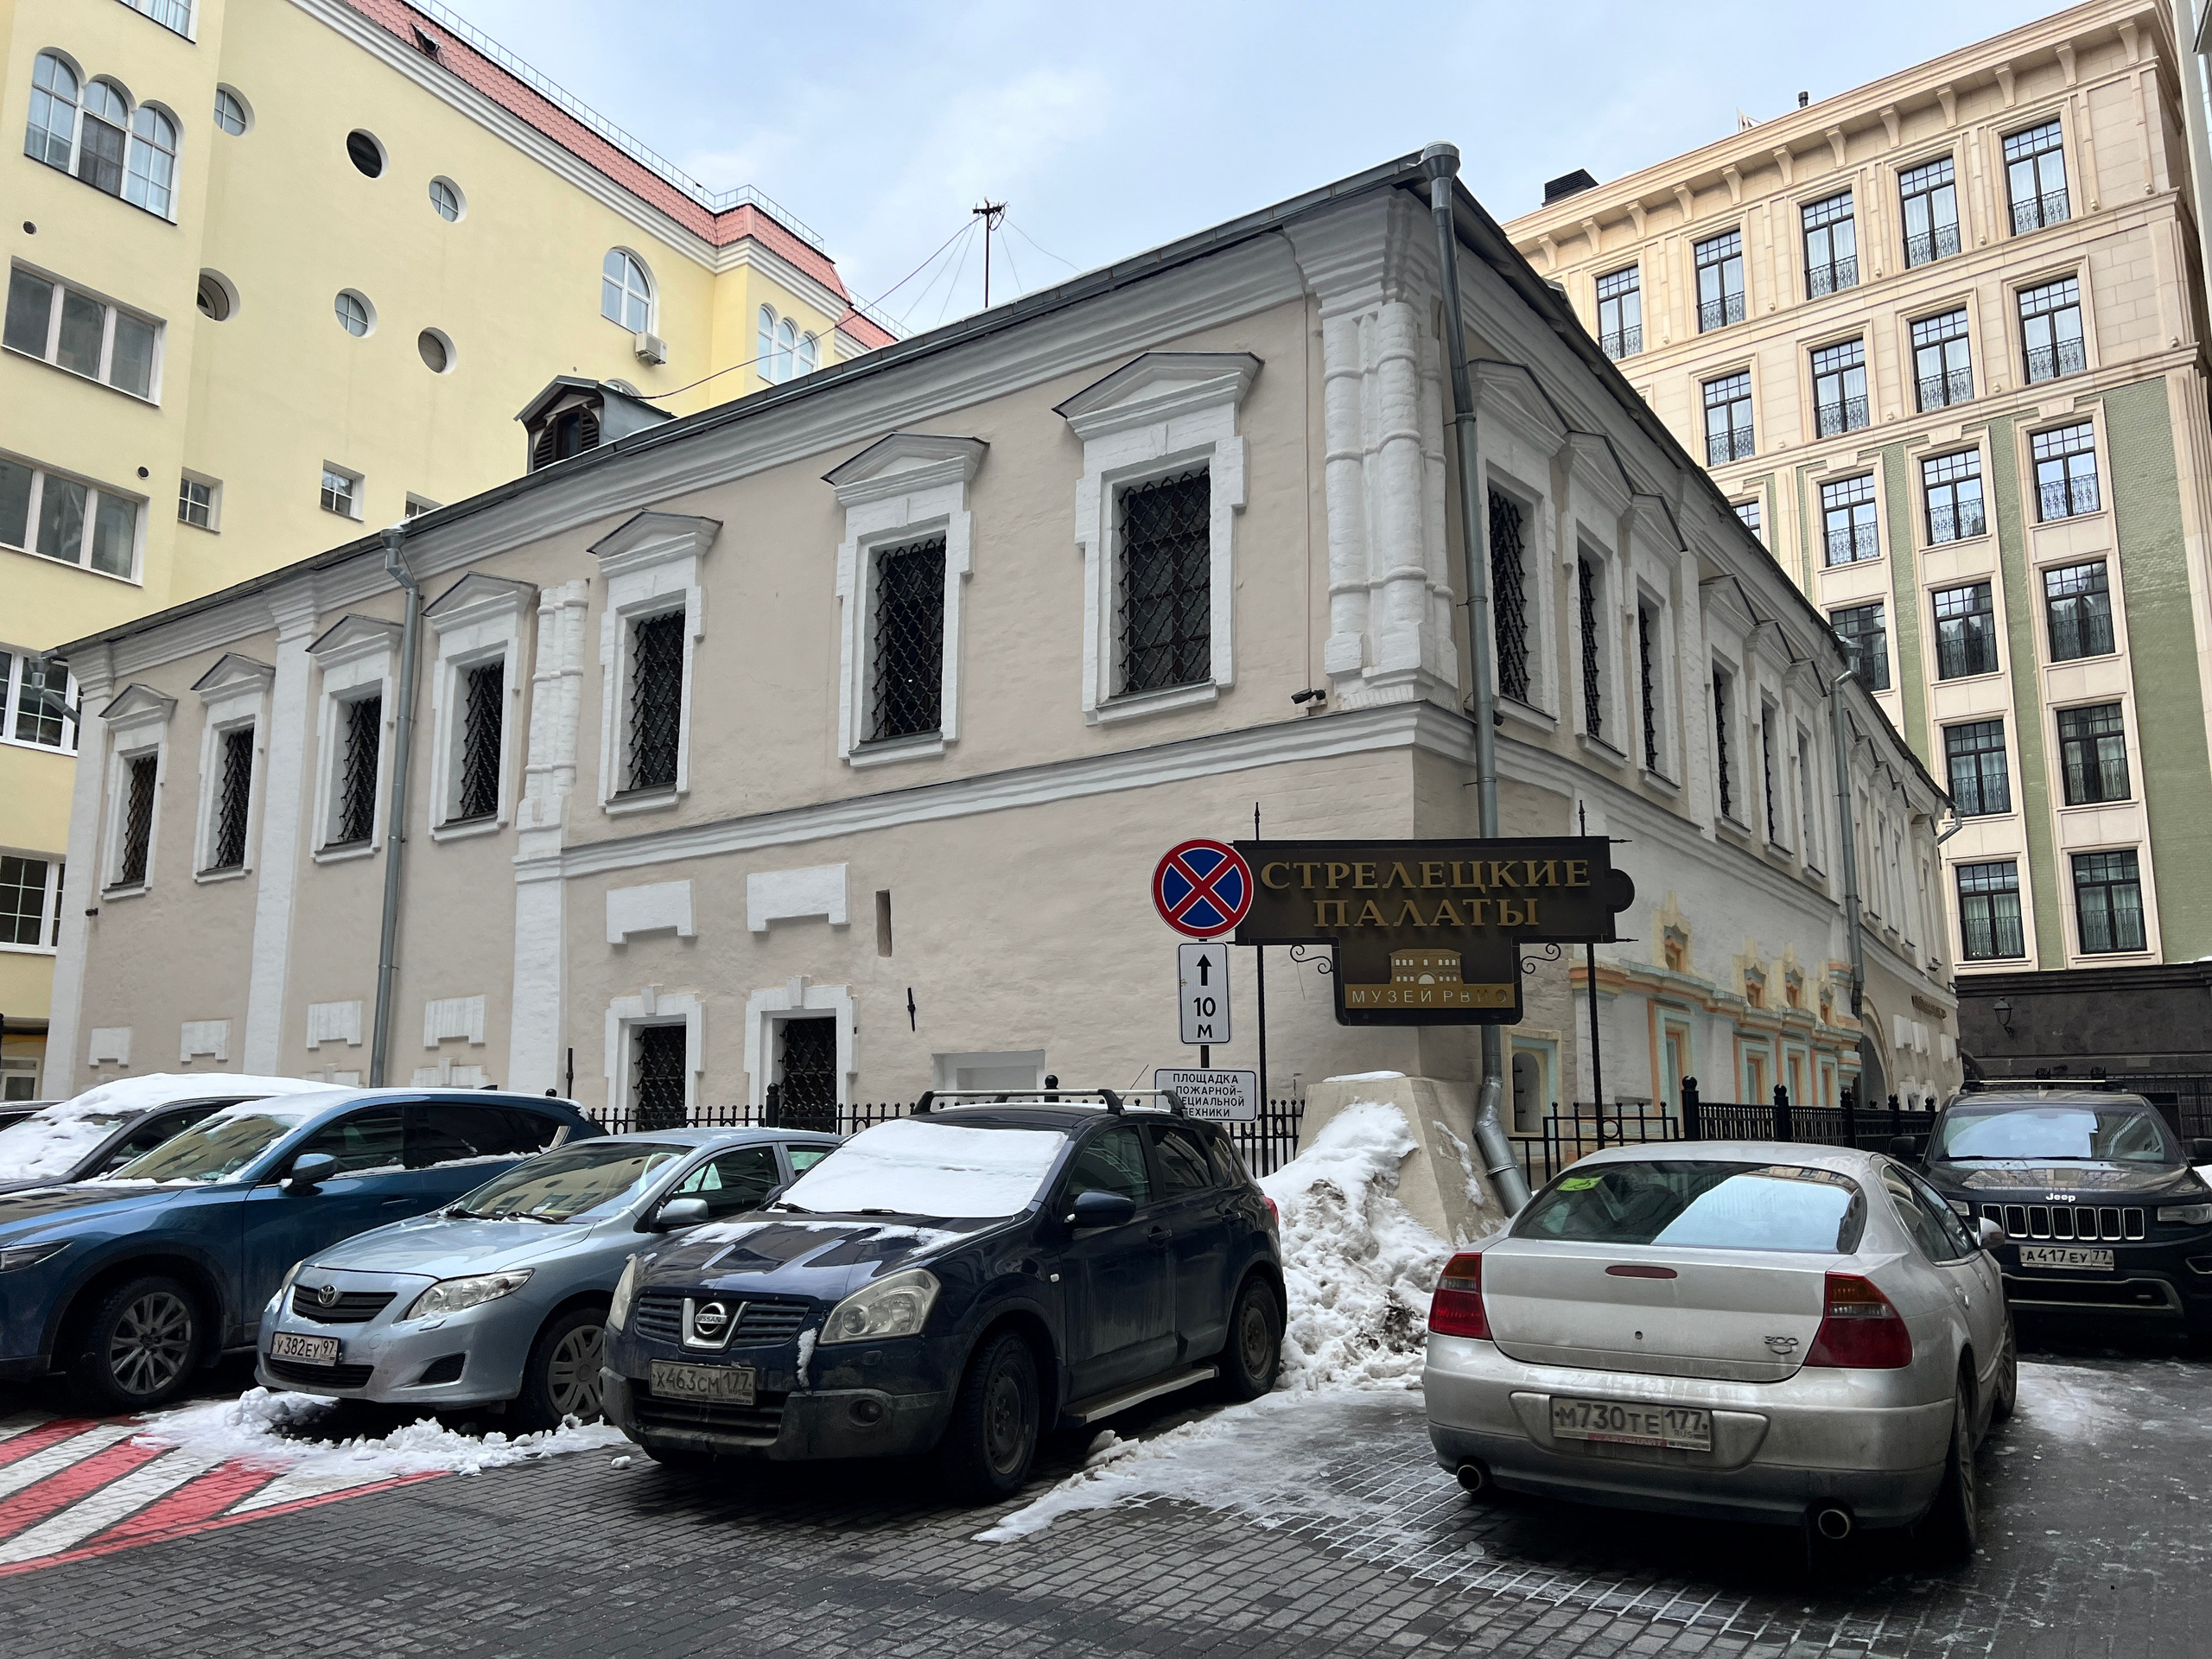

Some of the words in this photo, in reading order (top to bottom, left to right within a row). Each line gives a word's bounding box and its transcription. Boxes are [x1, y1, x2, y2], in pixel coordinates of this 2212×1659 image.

[1261, 860, 1591, 893] СТРЕЛЕЦКИЕ
[1313, 899, 1539, 927] ПАЛАТЫ
[1352, 988, 1432, 1003] МУЗЕЙ
[1193, 997, 1217, 1017] 10
[1173, 1074, 1238, 1084] ПЛОЩАДКА
[1181, 1096, 1244, 1106] ЕЦИАЛЬНОЙ
[1185, 1108, 1230, 1117] ЕХНИКИ
[2045, 1193, 2076, 1203] Jeep
[2026, 1249, 2088, 1263] А417ЕУ
[2093, 1250, 2107, 1261] 77
[276, 1337, 320, 1357] У382ЕУ
[323, 1340, 334, 1354] 97
[657, 1369, 719, 1394] Х463СМ
[723, 1372, 749, 1389] 177
[1560, 1403, 1659, 1434] М730ТЕ
[1665, 1410, 1701, 1430] 177
[1674, 1429, 1694, 1439] RUS
